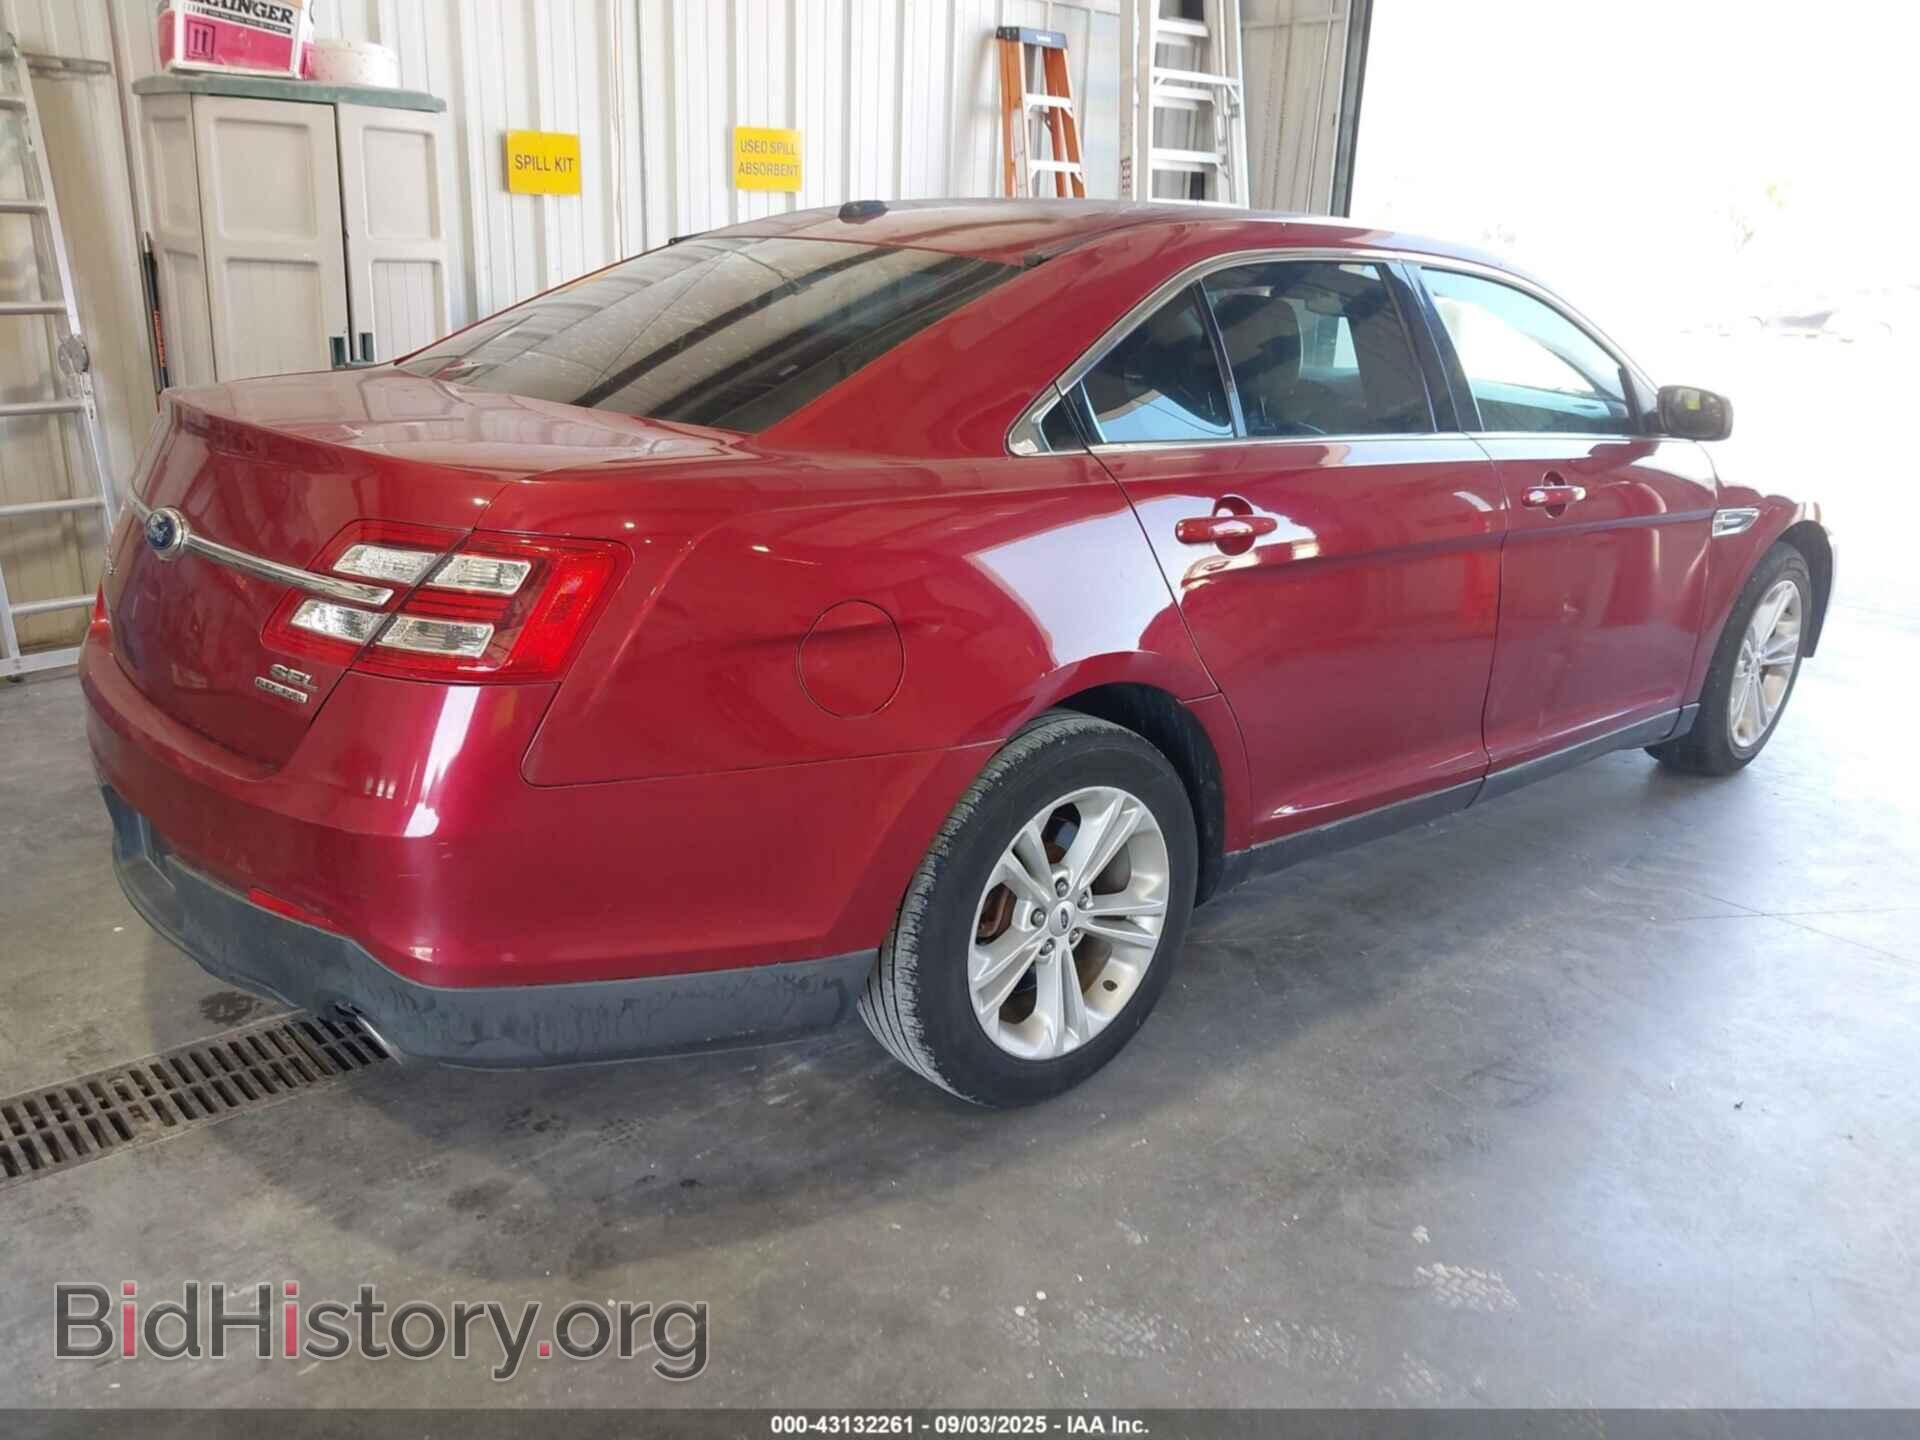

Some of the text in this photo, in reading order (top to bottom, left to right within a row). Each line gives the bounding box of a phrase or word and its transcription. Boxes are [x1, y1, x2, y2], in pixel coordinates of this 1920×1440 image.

[740, 139, 796, 155] USED SPILL
[515, 154, 574, 173] SPILL KIT
[738, 161, 800, 177] ABSORBENT
